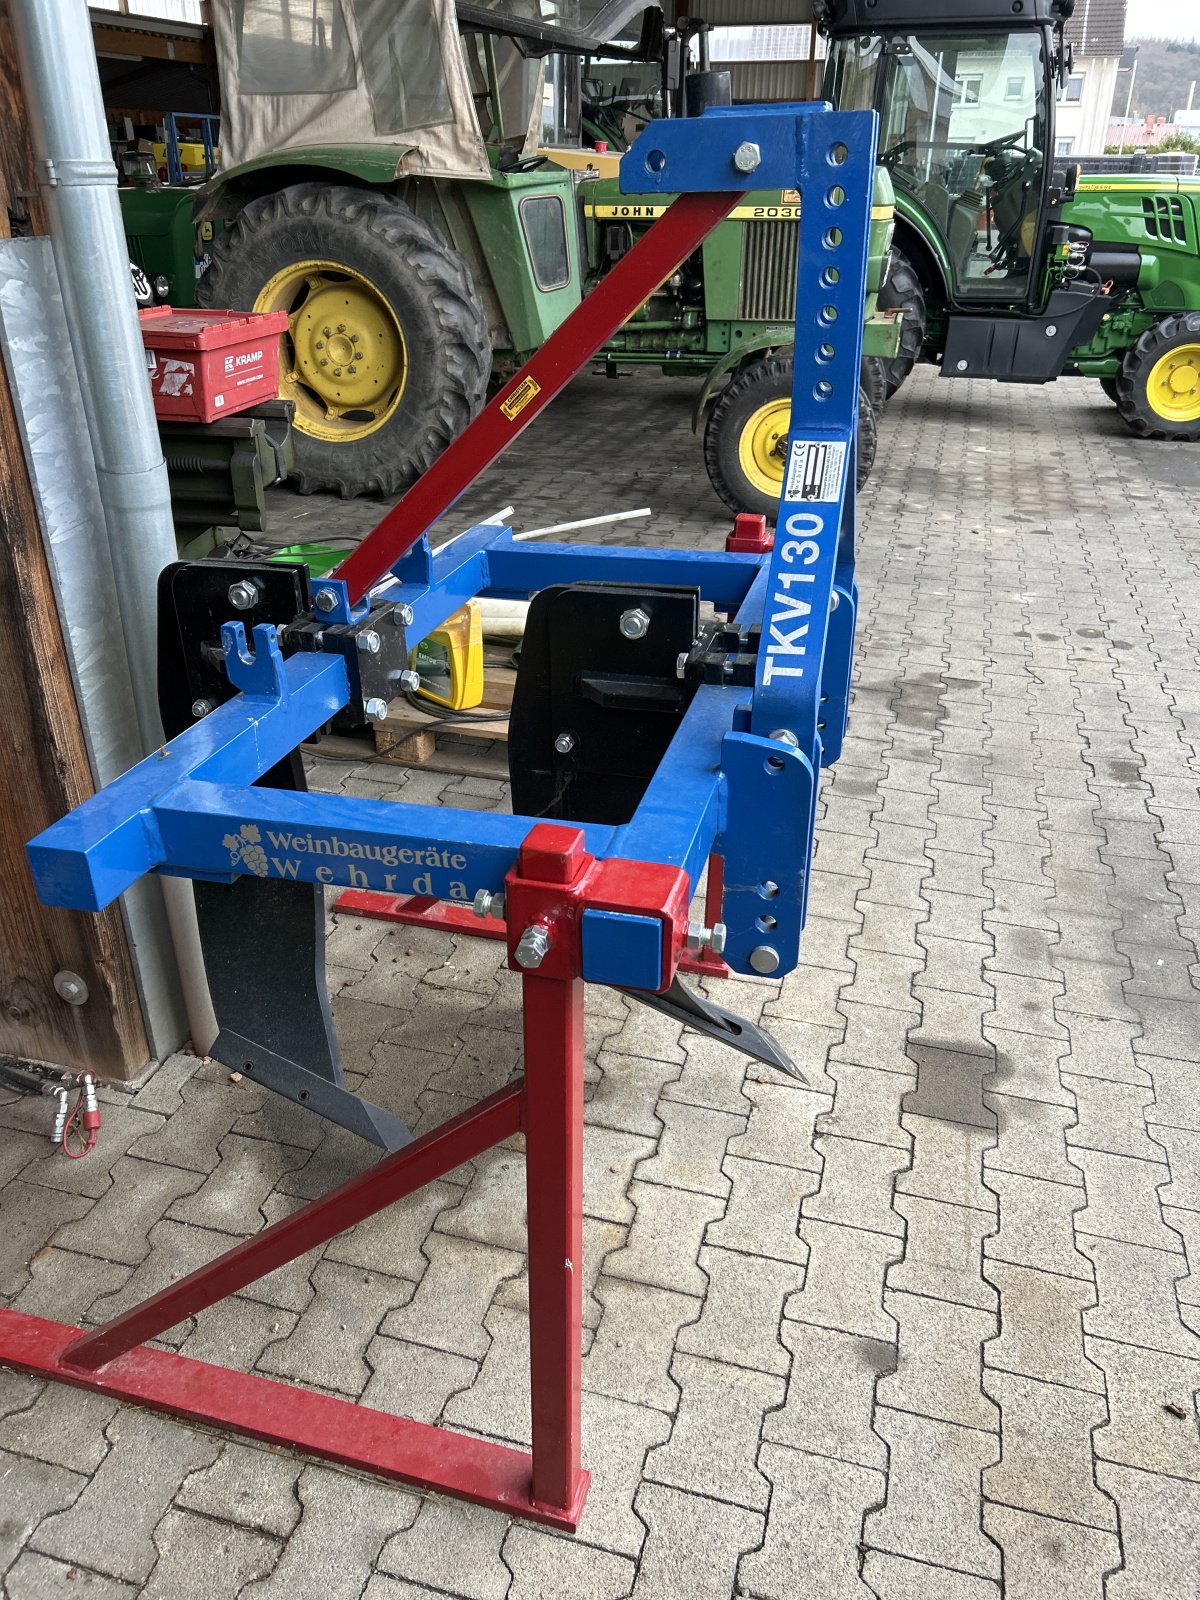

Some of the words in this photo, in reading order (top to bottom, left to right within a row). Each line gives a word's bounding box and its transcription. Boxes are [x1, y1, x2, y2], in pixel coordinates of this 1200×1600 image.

[612, 206, 654, 216] JOHN
[235, 350, 263, 367] KRAMP
[762, 512, 825, 686] TKV130
[266, 830, 467, 870] Weinbaugeräte
[270, 857, 469, 900] Wehrda
